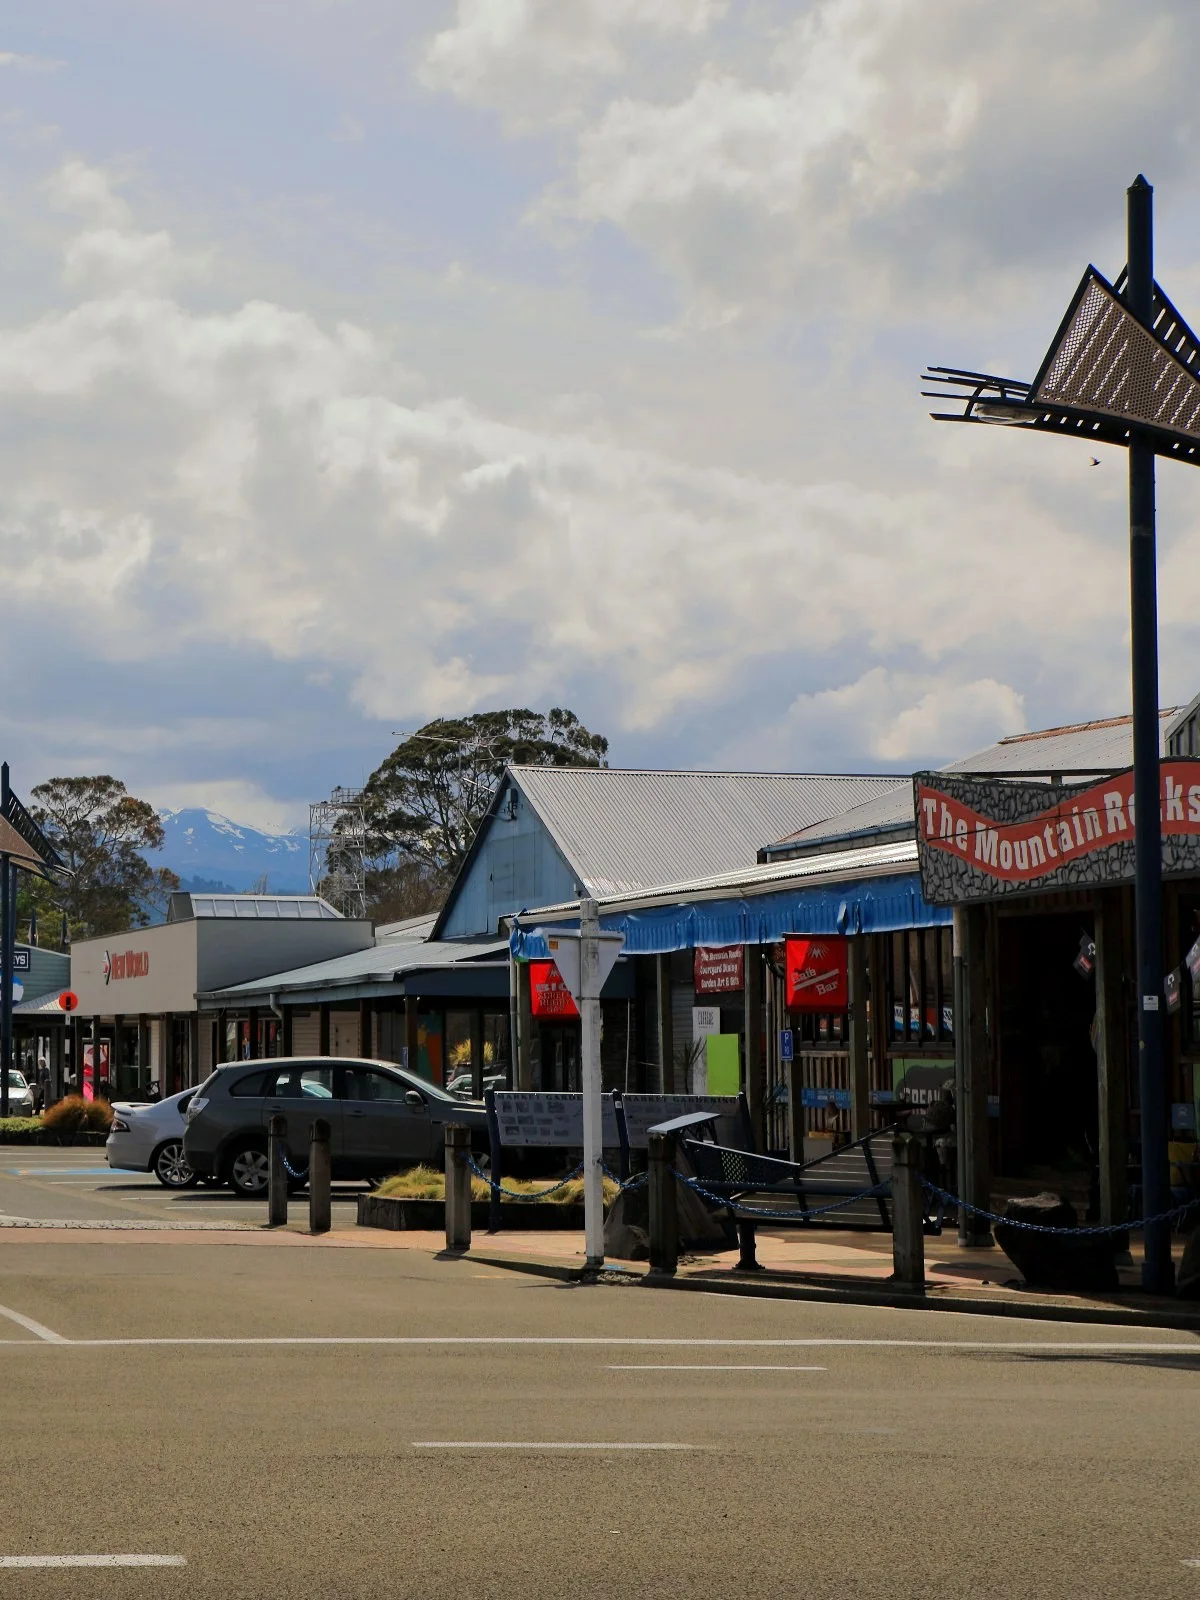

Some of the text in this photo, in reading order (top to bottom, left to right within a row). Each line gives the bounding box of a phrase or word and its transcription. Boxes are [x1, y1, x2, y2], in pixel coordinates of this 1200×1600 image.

[922, 797, 969, 851] The
[974, 805, 1103, 870] Mountain
[815, 980, 839, 996] Bar
